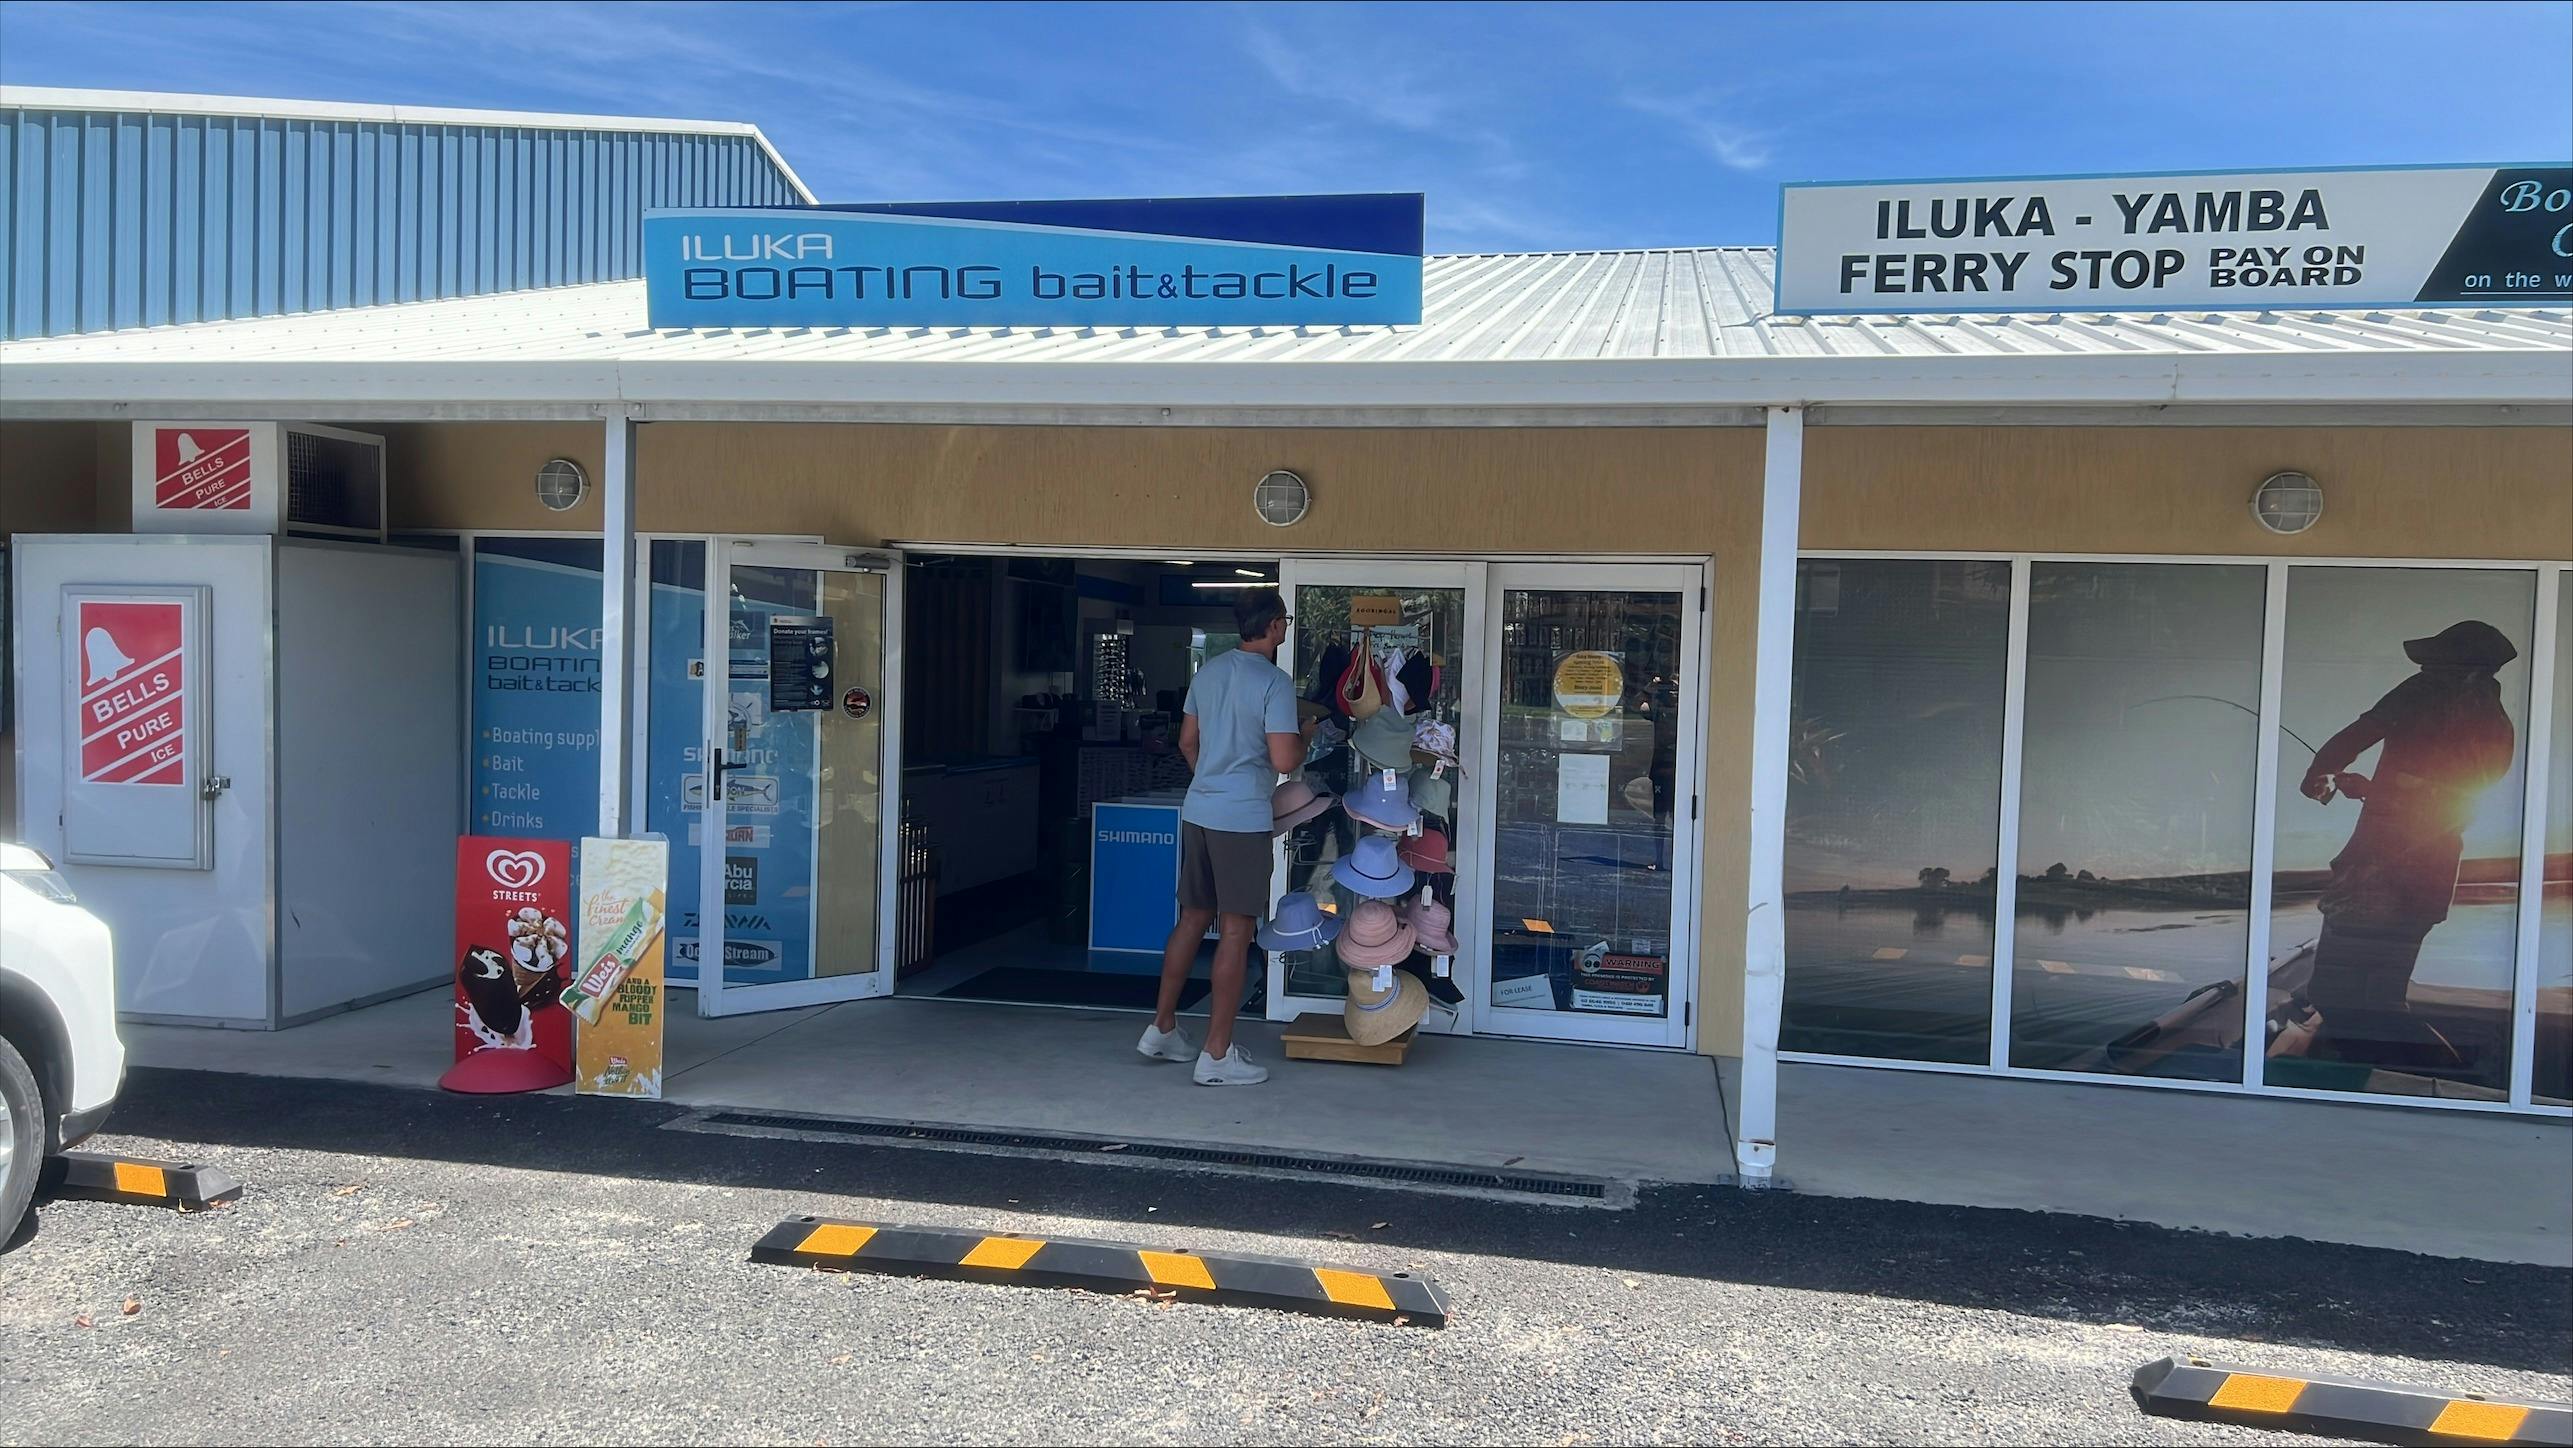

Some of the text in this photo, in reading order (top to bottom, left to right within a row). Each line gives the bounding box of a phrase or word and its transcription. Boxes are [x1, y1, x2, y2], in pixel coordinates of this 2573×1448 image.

[1876, 196, 2056, 239] ILUKA
[2112, 189, 2330, 234] YAMBA
[683, 234, 832, 261] ILUKA
[2209, 245, 2365, 267] PAY ON
[1840, 248, 2186, 294] FERRY STOP
[2209, 265, 2364, 288] BOARD
[2464, 274, 2491, 288] on
[2505, 271, 2541, 288] the
[684, 263, 1378, 301] BOATING bait&tackle
[182, 457, 224, 485] BELLS
[196, 478, 226, 500] PURE
[213, 496, 227, 507] ICE
[488, 656, 601, 673] BOATIN
[488, 674, 602, 693] bait&tack
[92, 672, 170, 723] BELLS
[117, 712, 173, 750] PURE
[492, 727, 600, 750] Boating suppl
[151, 744, 175, 763] ICE
[492, 755, 524, 772] Bait
[492, 783, 541, 800] Tackle
[492, 811, 543, 829] Drinks
[1098, 830, 1175, 845] SHIMANO
[725, 879, 753, 891] rcia
[493, 890, 538, 902] STREETS
[616, 921, 643, 955] mango
[725, 946, 769, 960] Stream
[1606, 959, 1660, 969] WARNING
[583, 961, 616, 992] Weis
[619, 984, 657, 994] BLOODY
[1501, 985, 1532, 996] FOR LEASE
[613, 1003, 650, 1012] MANGO
[620, 994, 654, 1003] RIPPER
[629, 1013, 652, 1025] BIT
